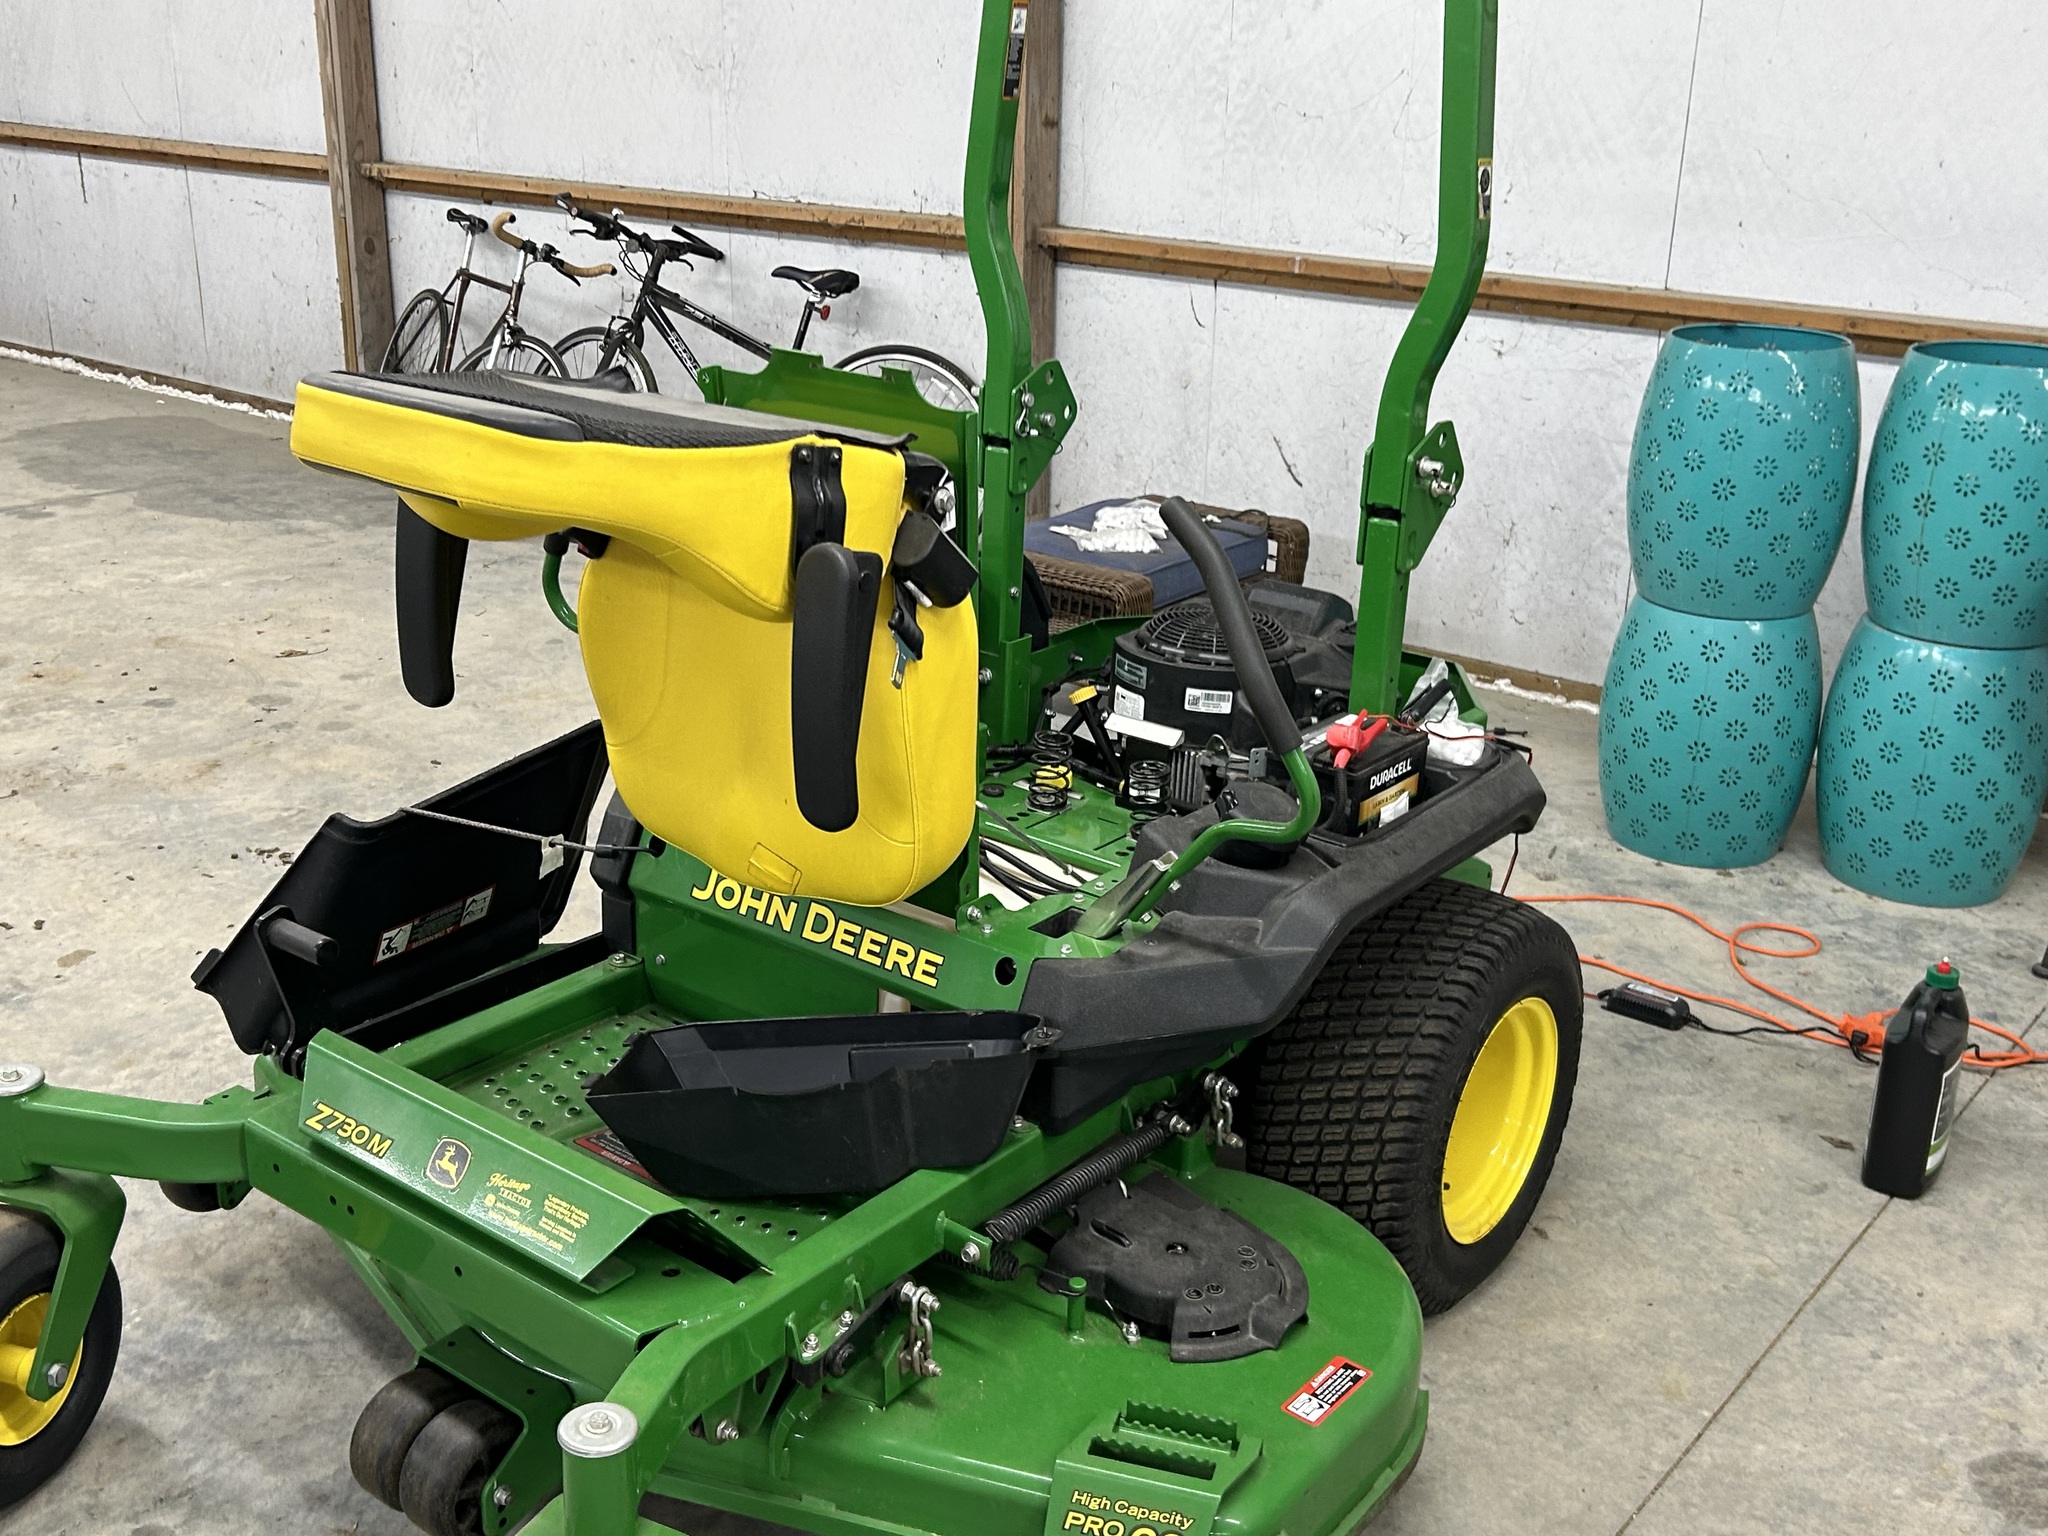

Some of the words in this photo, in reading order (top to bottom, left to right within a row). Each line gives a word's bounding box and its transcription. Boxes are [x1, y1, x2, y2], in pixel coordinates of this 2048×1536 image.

[1370, 758, 1412, 790] DURACELL
[691, 868, 799, 933] JOHN
[801, 901, 945, 988] DEERE
[304, 1101, 394, 1159] Z730M
[485, 1172, 532, 1193] Heritage
[1062, 1510, 1126, 1536] PRO
[1071, 1490, 1111, 1511] High
[1114, 1499, 1195, 1531] Capacity
